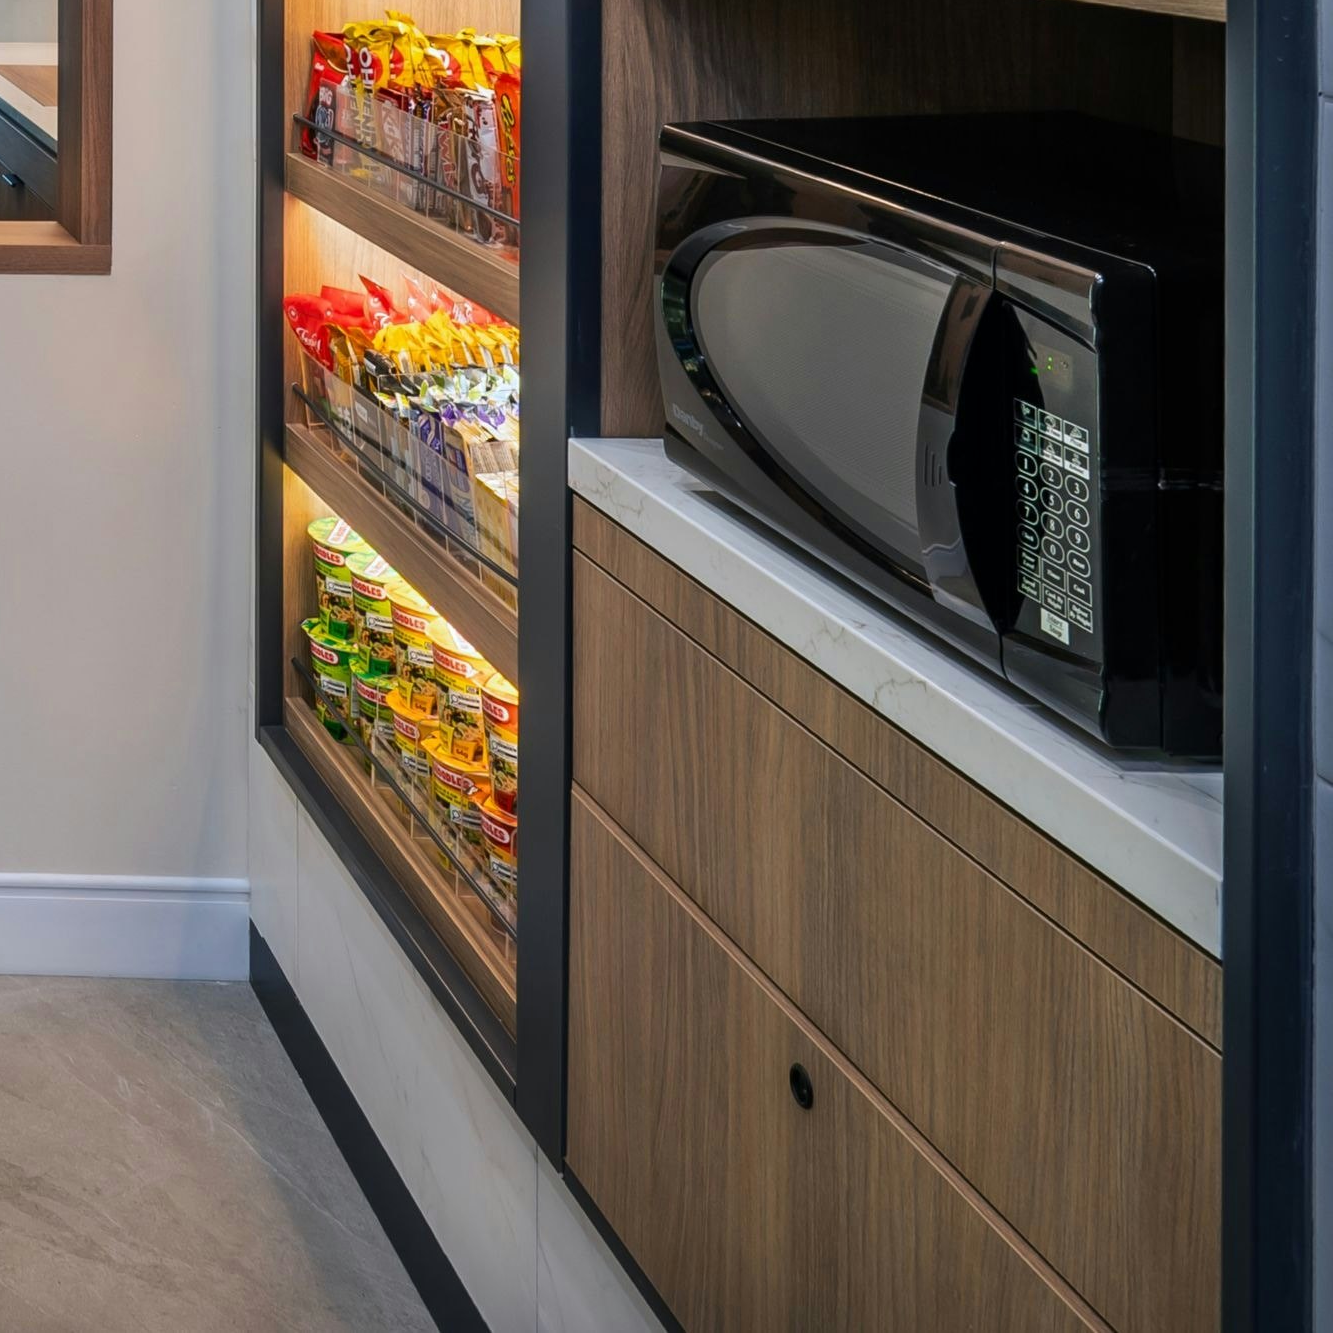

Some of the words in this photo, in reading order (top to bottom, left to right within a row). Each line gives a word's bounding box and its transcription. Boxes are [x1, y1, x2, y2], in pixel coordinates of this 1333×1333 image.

[1048, 470, 1055, 482] 2
[1023, 482, 1030, 494] 4
[1074, 482, 1080, 495] 3
[1049, 494, 1055, 507] 5
[1024, 506, 1030, 518] 7
[1074, 508, 1081, 520] 6
[1049, 519, 1056, 532] 8
[1074, 532, 1081, 545] 9
[1050, 544, 1057, 556] 0
